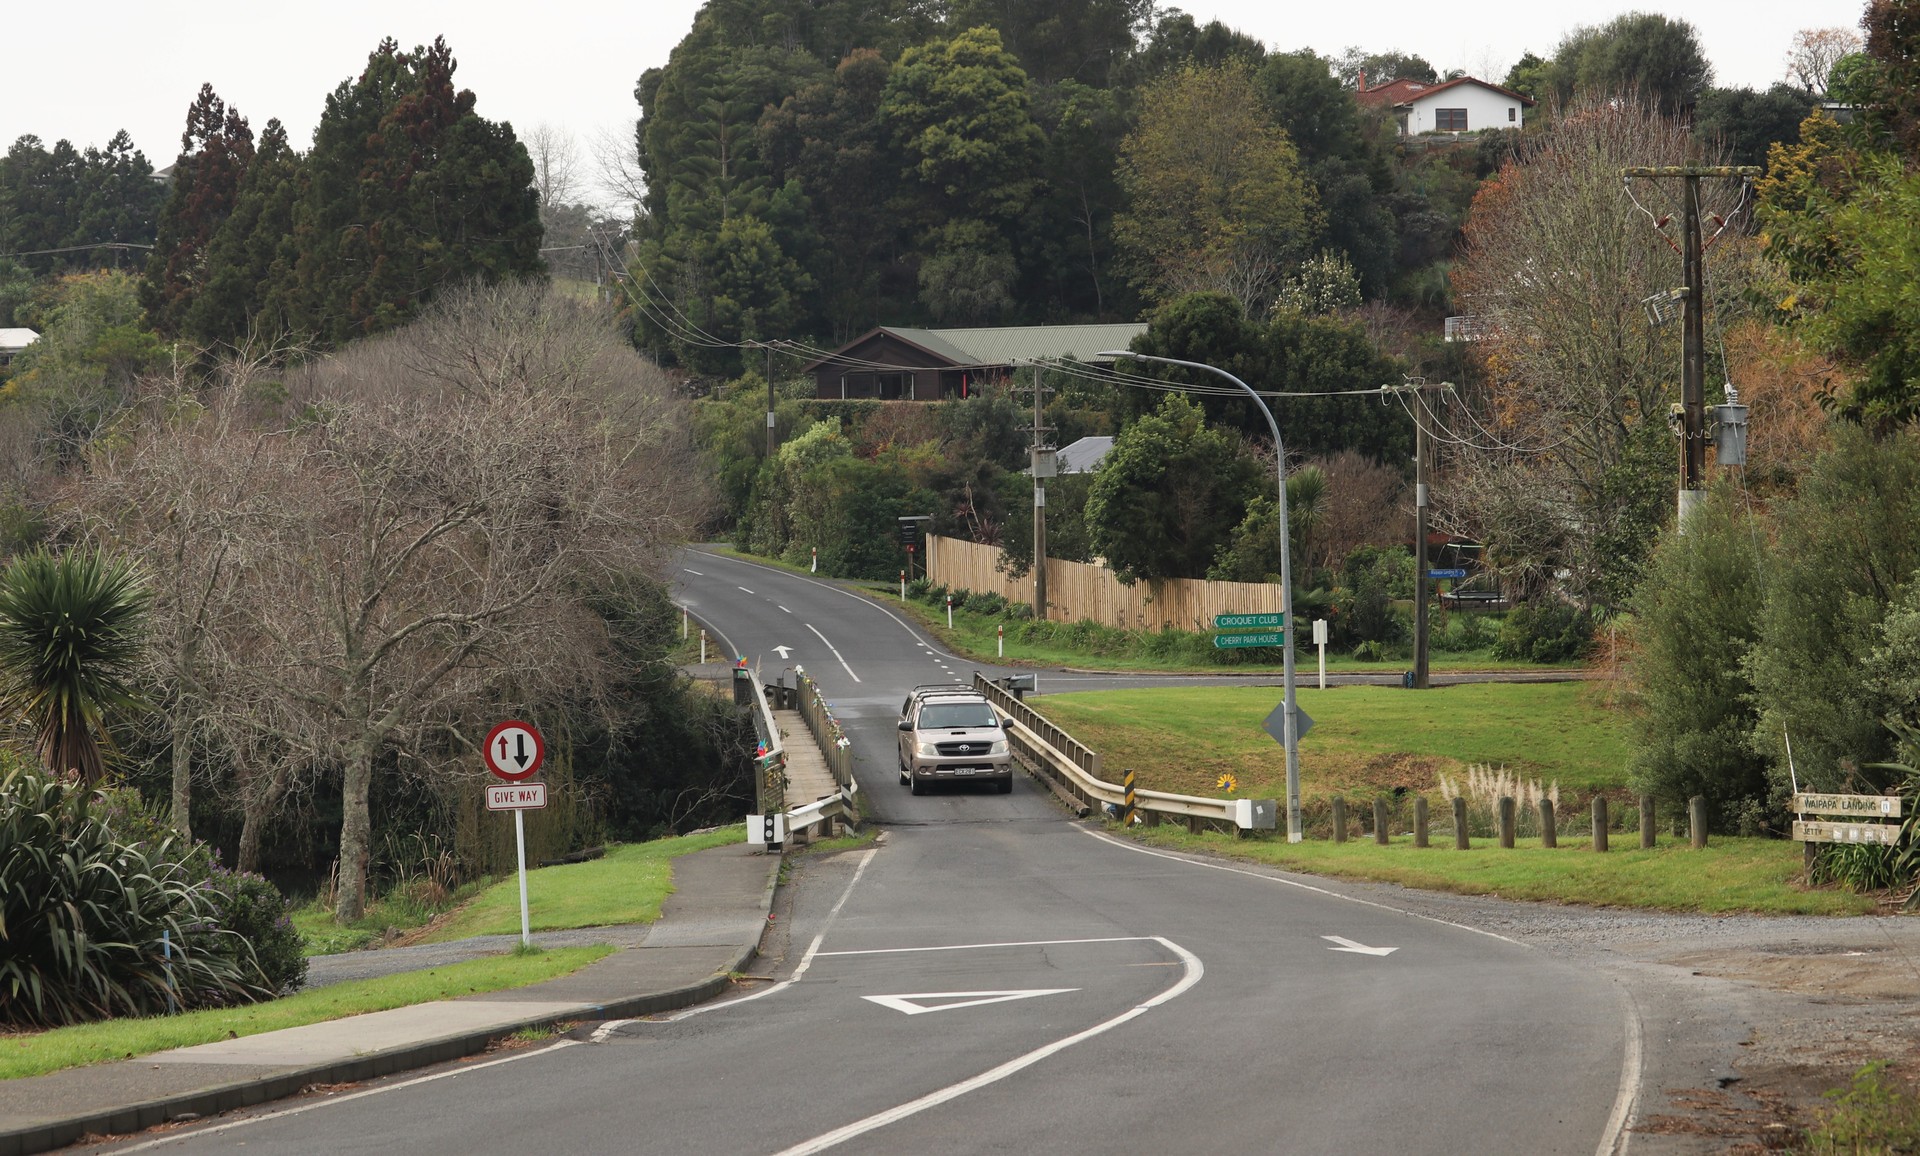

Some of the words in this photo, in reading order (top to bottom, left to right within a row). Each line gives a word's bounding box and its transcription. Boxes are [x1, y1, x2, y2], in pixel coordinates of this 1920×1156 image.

[1221, 616, 1256, 625] CROQUET
[1259, 616, 1278, 624] CLUB
[1221, 637, 1242, 645] CHERRY
[1259, 635, 1277, 643] HOUSE
[494, 791, 515, 803] GIVE
[518, 790, 537, 801] WAY
[1804, 799, 1837, 810] WAIPAPA
[1842, 801, 1876, 811] LANDING
[1803, 828, 1822, 836] JETTY
